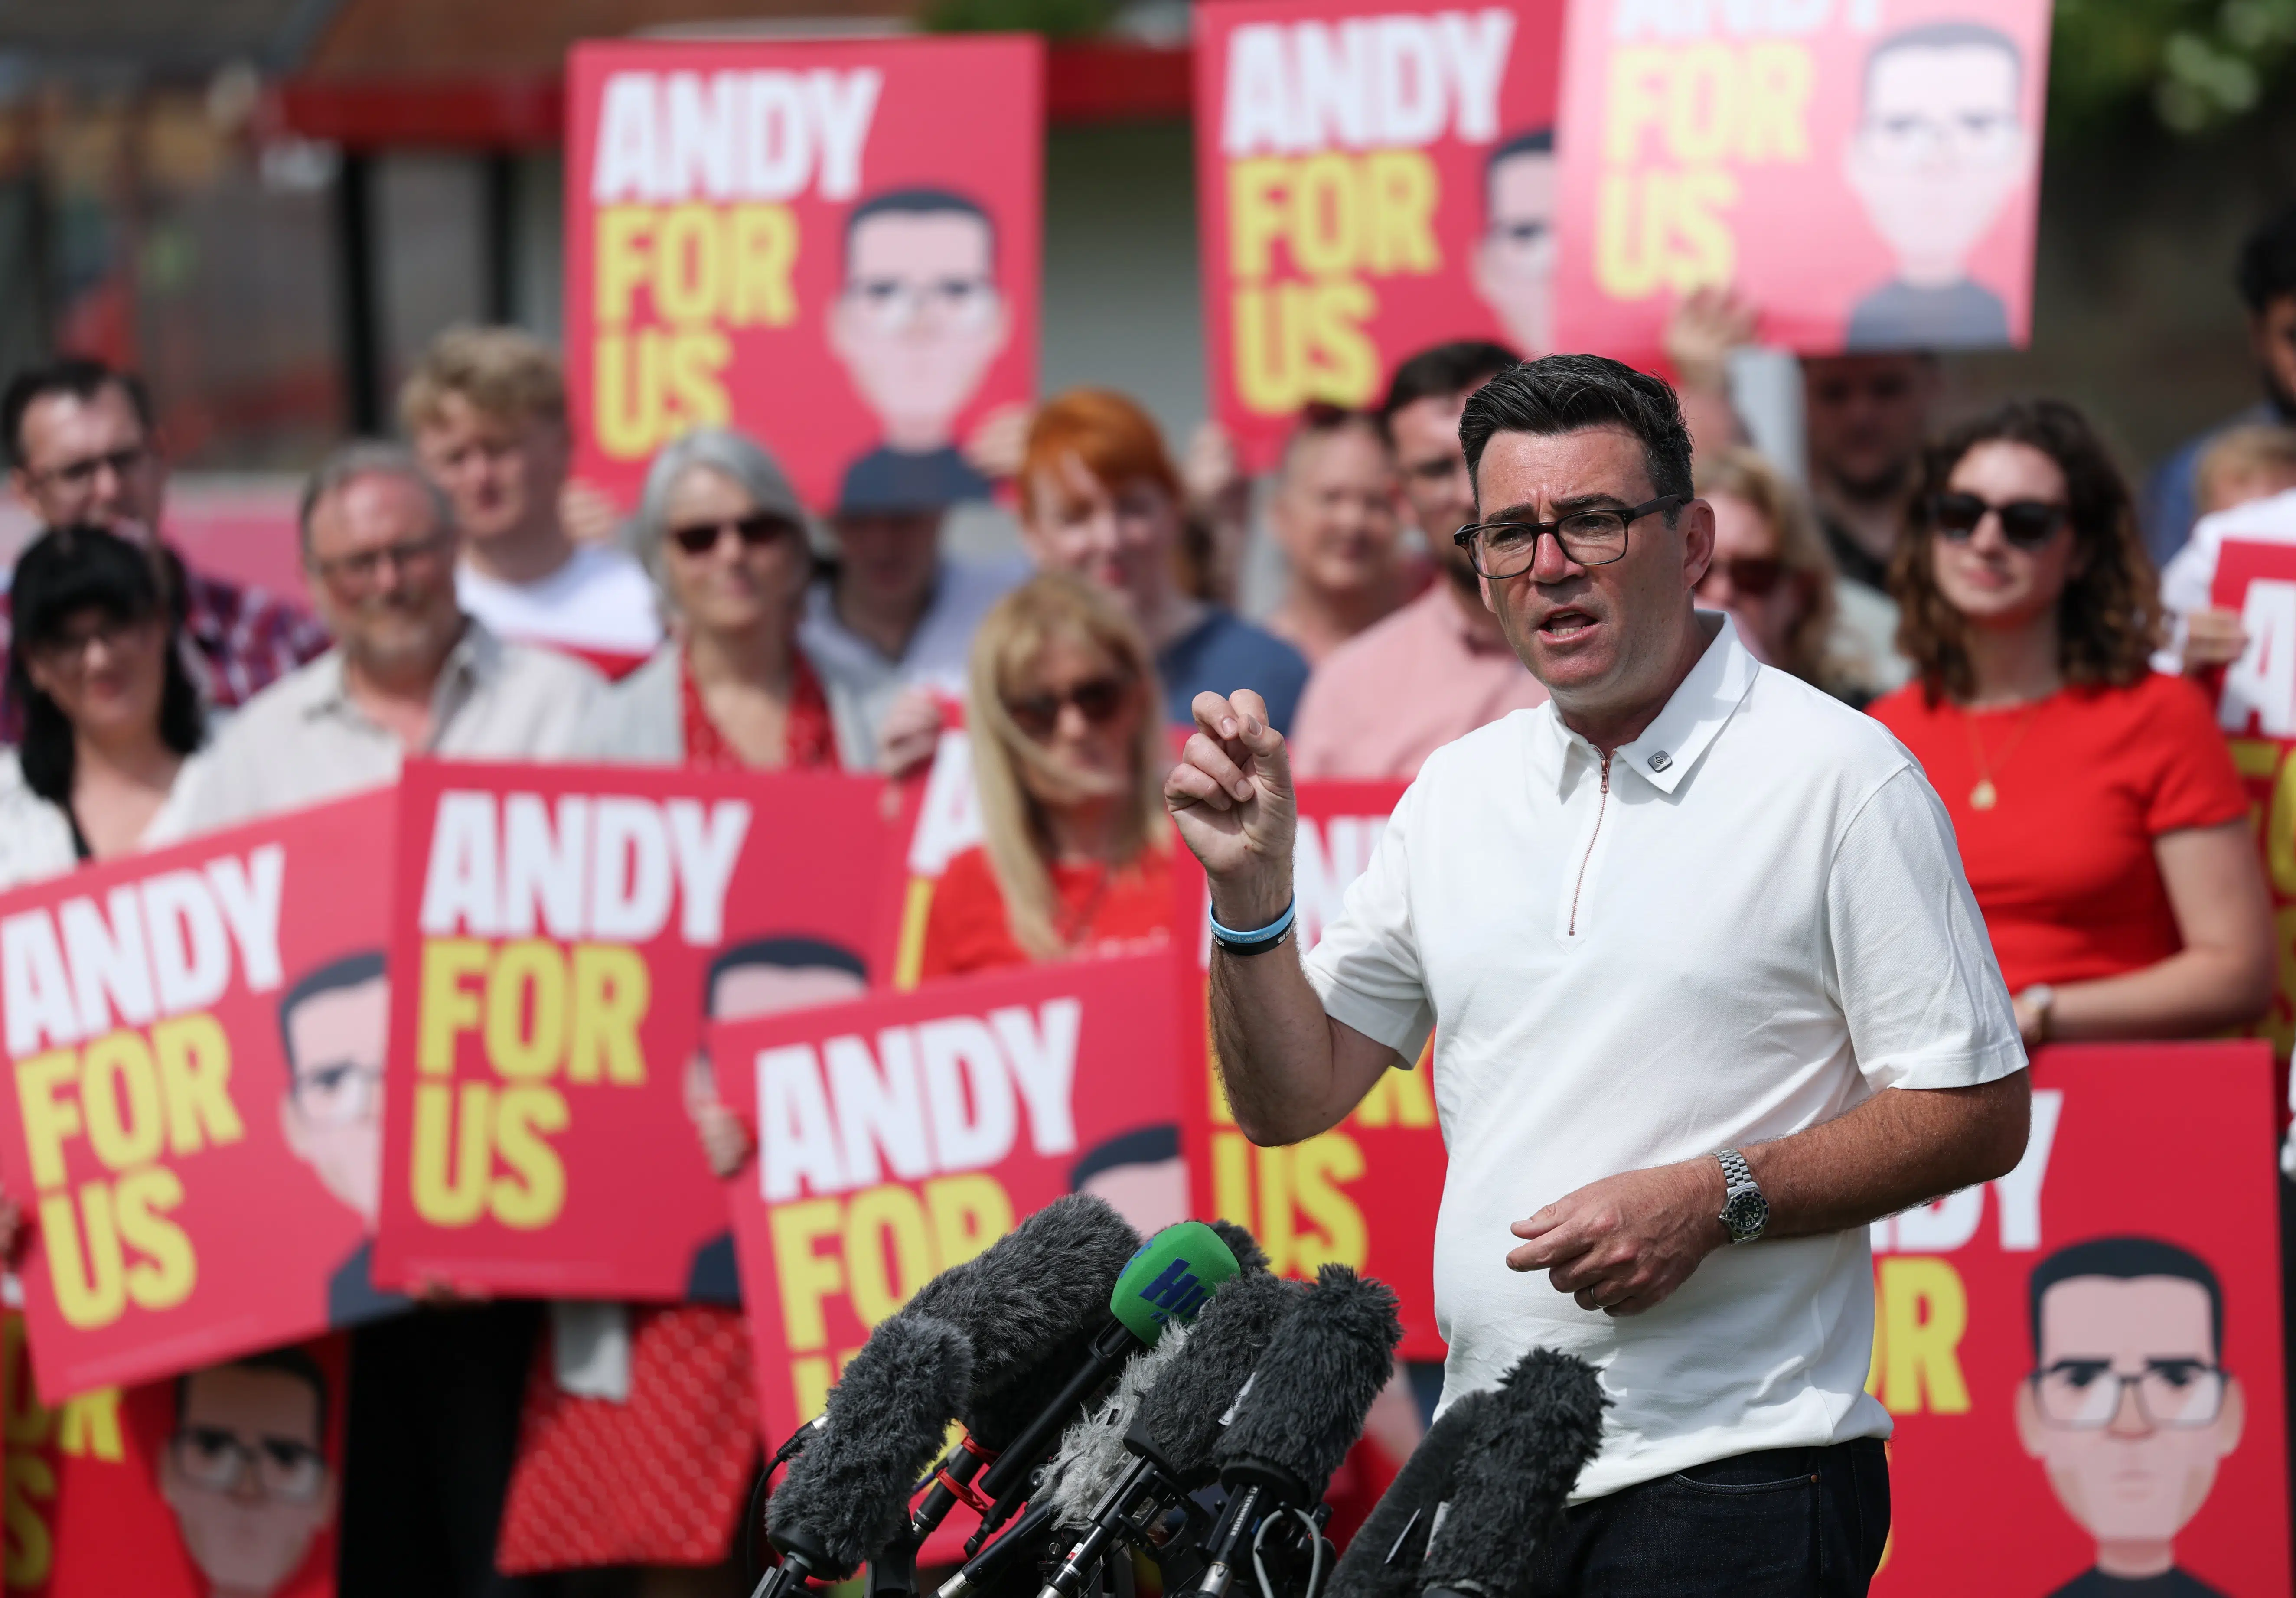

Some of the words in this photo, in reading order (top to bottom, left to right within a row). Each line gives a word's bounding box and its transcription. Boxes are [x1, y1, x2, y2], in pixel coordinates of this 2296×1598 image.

[594, 69, 880, 204] ANDY
[1224, 12, 1512, 156] ANDY
[1603, 40, 1812, 164] FOR
[596, 201, 799, 328] FOR
[1230, 147, 1438, 280] FOR
[1593, 167, 1739, 300] US
[594, 327, 732, 457] US
[1234, 277, 1378, 414] US
[421, 792, 751, 943] ANDY
[1, 845, 284, 1061] ANDY
[418, 936, 649, 1086] FOR
[15, 1012, 243, 1191] FOR
[411, 1079, 569, 1229] US
[755, 996, 1080, 1202] ANDY
[38, 1163, 198, 1329] US
[1214, 1132, 1368, 1285] US
